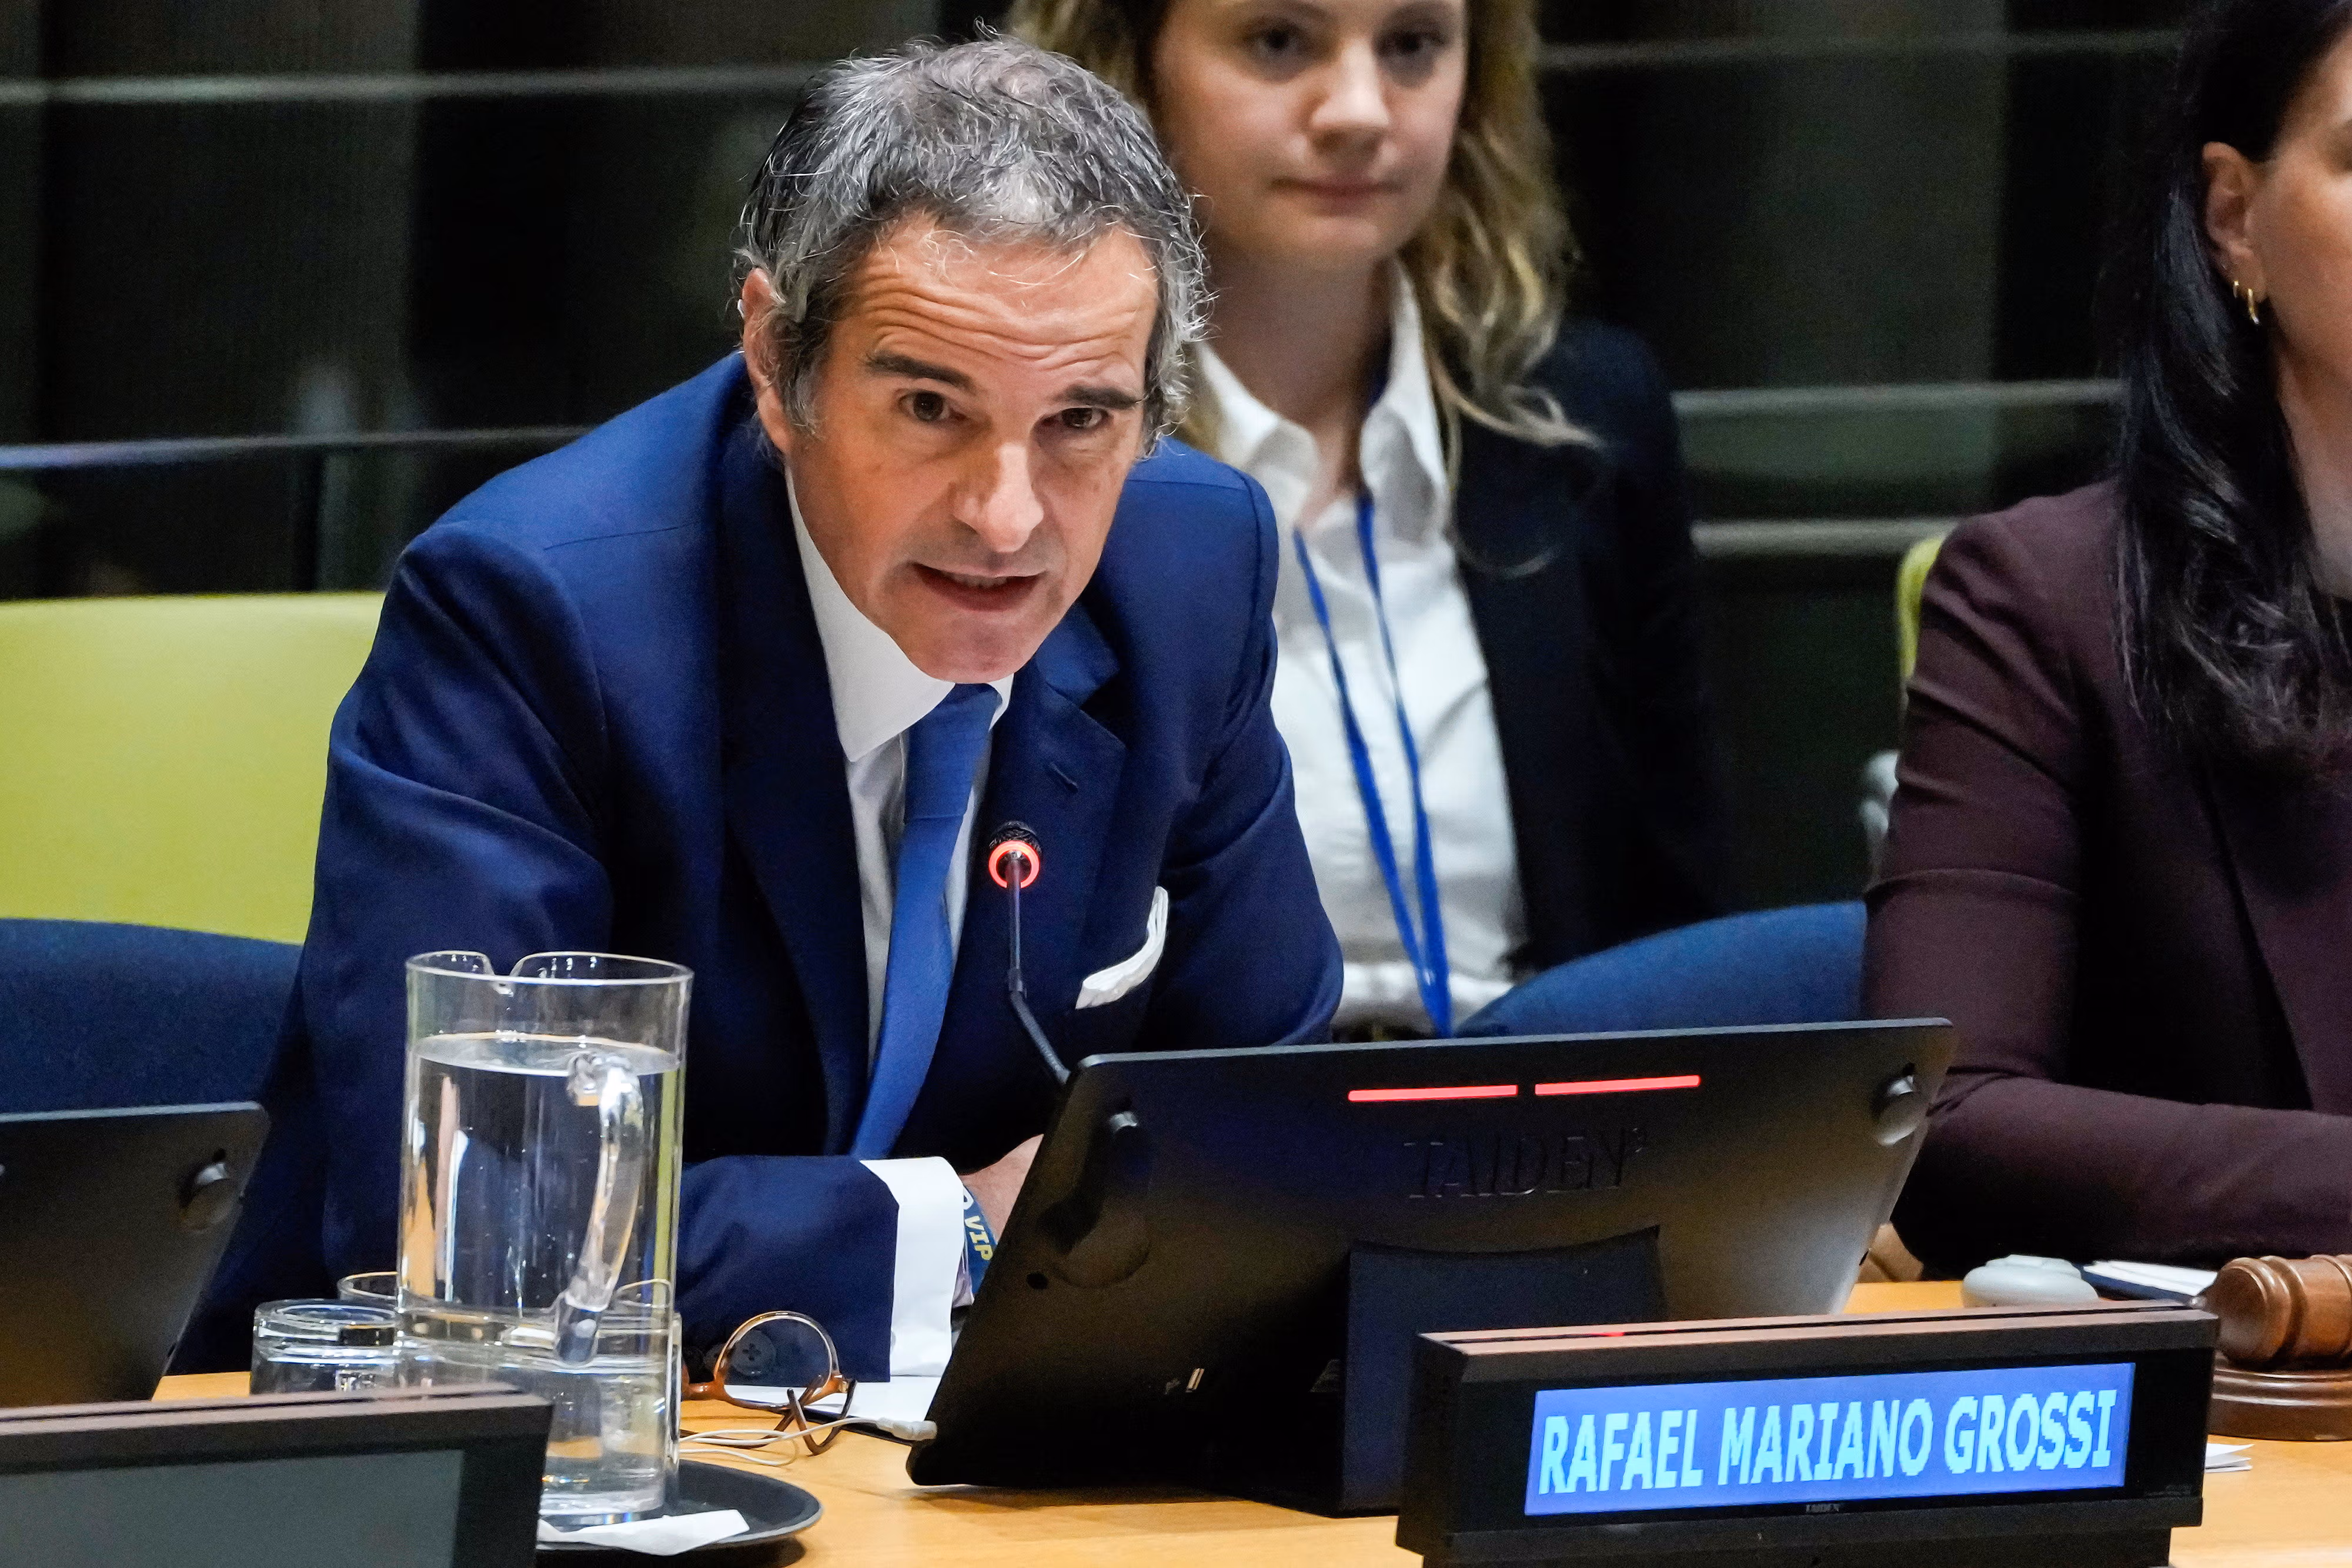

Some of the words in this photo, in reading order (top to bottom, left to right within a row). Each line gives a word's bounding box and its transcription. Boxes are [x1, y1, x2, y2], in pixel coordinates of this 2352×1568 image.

[964, 1215, 993, 1261] VIP
[1539, 1409, 1703, 1494] RAFAEL
[1718, 1399, 1933, 1485] MARIANO
[1943, 1390, 2117, 1474] GROSSI
